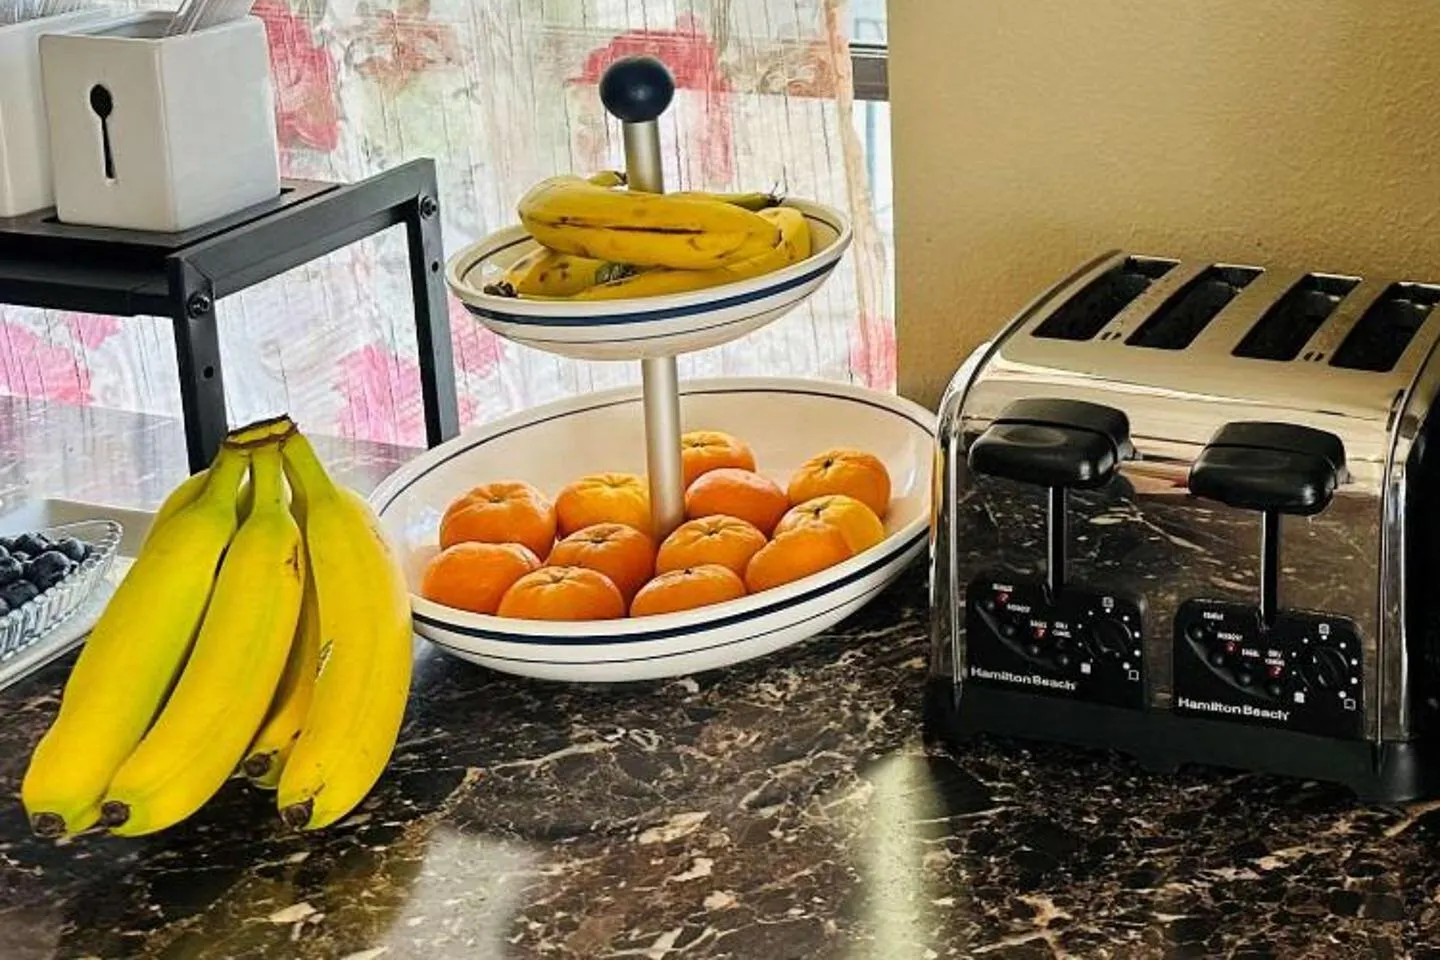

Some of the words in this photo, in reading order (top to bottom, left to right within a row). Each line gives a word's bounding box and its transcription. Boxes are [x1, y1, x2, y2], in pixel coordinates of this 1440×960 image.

[970, 666, 1032, 685] Hamilton
[1032, 675, 1076, 690] Beach
[1178, 697, 1241, 715] Hamilton
[1243, 704, 1290, 721] Beach
